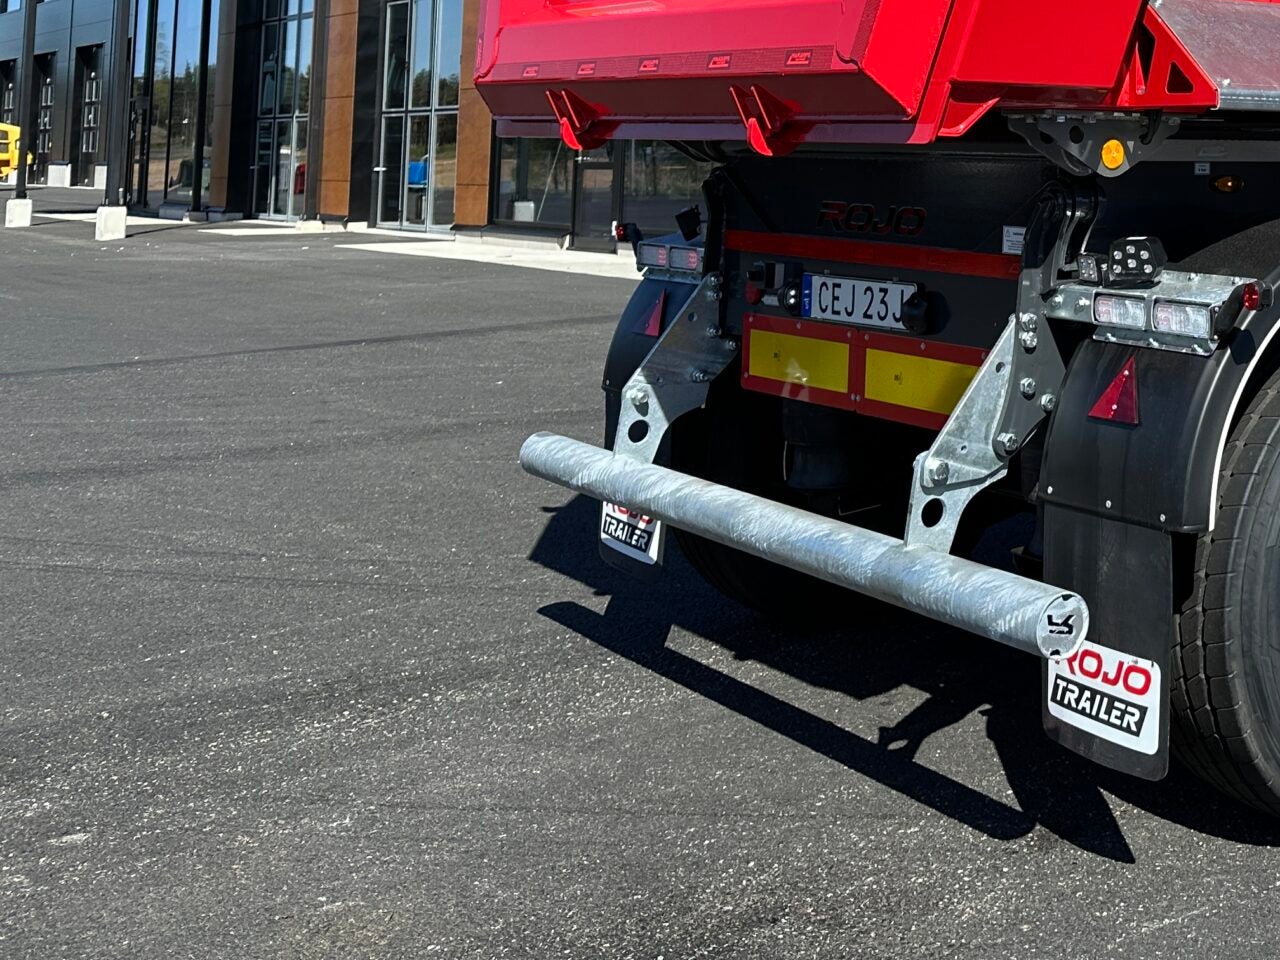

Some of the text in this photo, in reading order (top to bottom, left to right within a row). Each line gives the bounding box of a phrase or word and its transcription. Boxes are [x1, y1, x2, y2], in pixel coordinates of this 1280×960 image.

[816, 201, 928, 236] ROJO
[818, 281, 856, 317] CEJ
[604, 515, 649, 550] TRAILER
[1055, 678, 1141, 732] TRAILER
